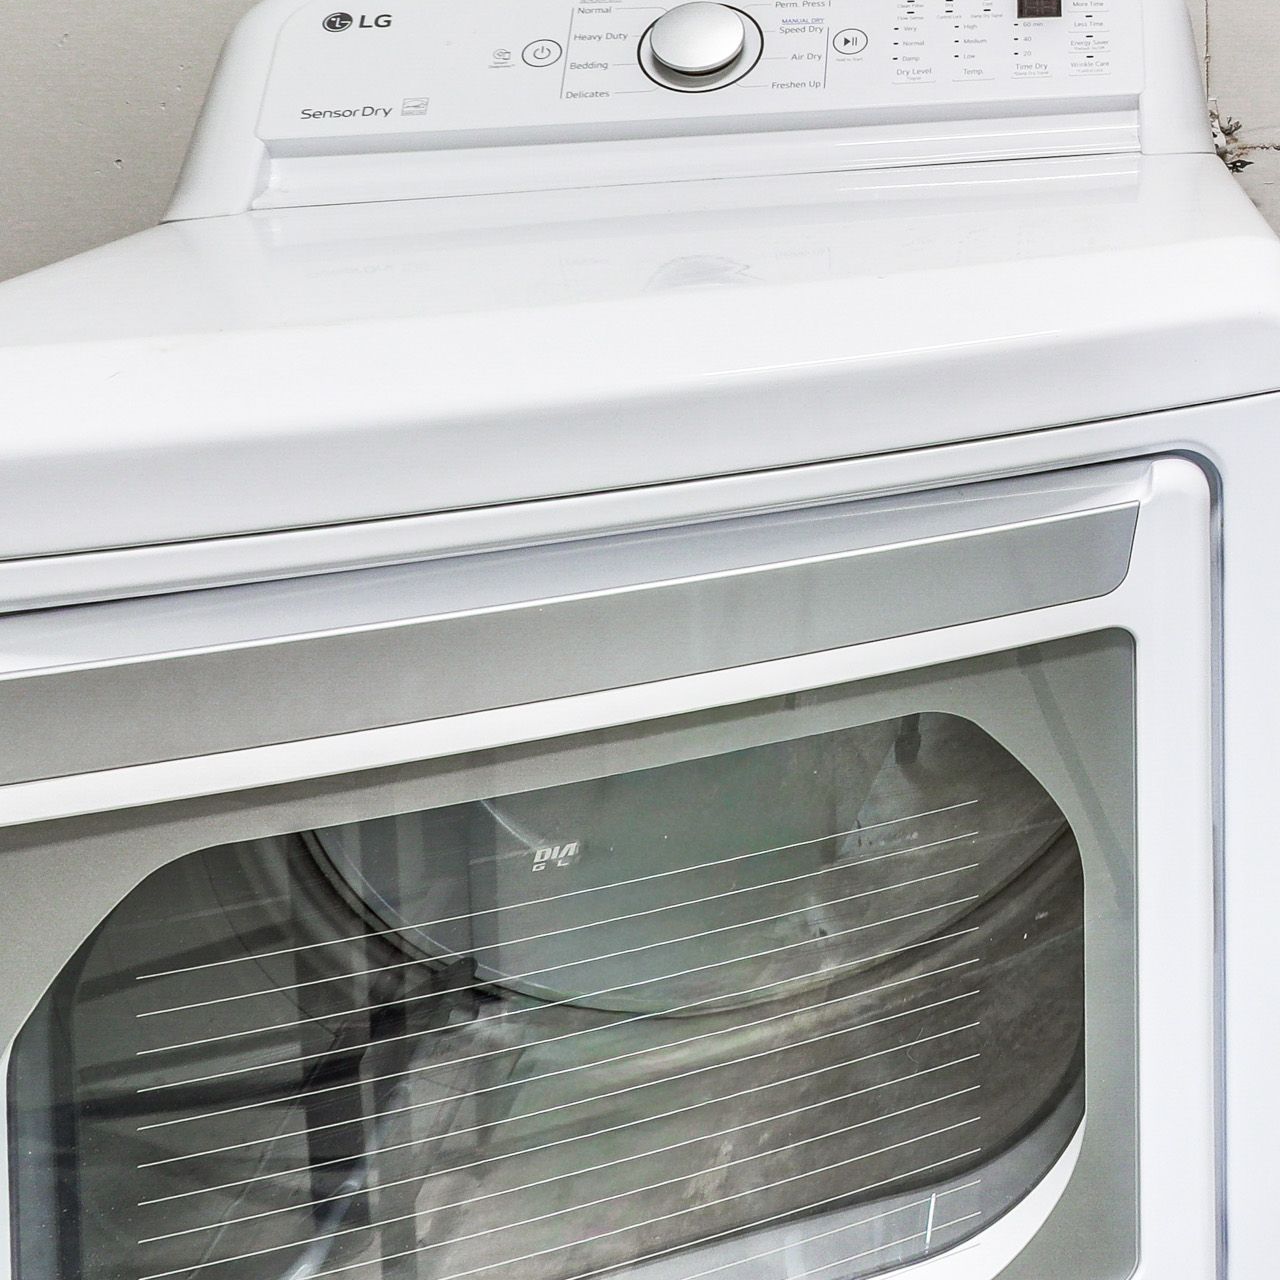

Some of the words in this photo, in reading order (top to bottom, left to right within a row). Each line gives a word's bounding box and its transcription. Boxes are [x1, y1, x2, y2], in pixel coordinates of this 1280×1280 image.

[775, 1, 799, 9] Perm.
[802, 0, 827, 8] Press
[577, 6, 612, 15] Normal
[358, 14, 393, 29] LG
[779, 25, 805, 35] Speed
[807, 25, 824, 34] Dry
[574, 33, 603, 42] Heavy
[605, 32, 628, 41] Duty
[791, 53, 805, 61] Air
[807, 52, 822, 62] Dry
[570, 61, 609, 71] Bedding
[1035, 62, 1048, 70] Dry
[896, 68, 910, 76] Dry
[912, 67, 932, 75] Level
[771, 80, 807, 89] Freshen
[810, 80, 822, 89] Up
[565, 90, 611, 99] Delicates
